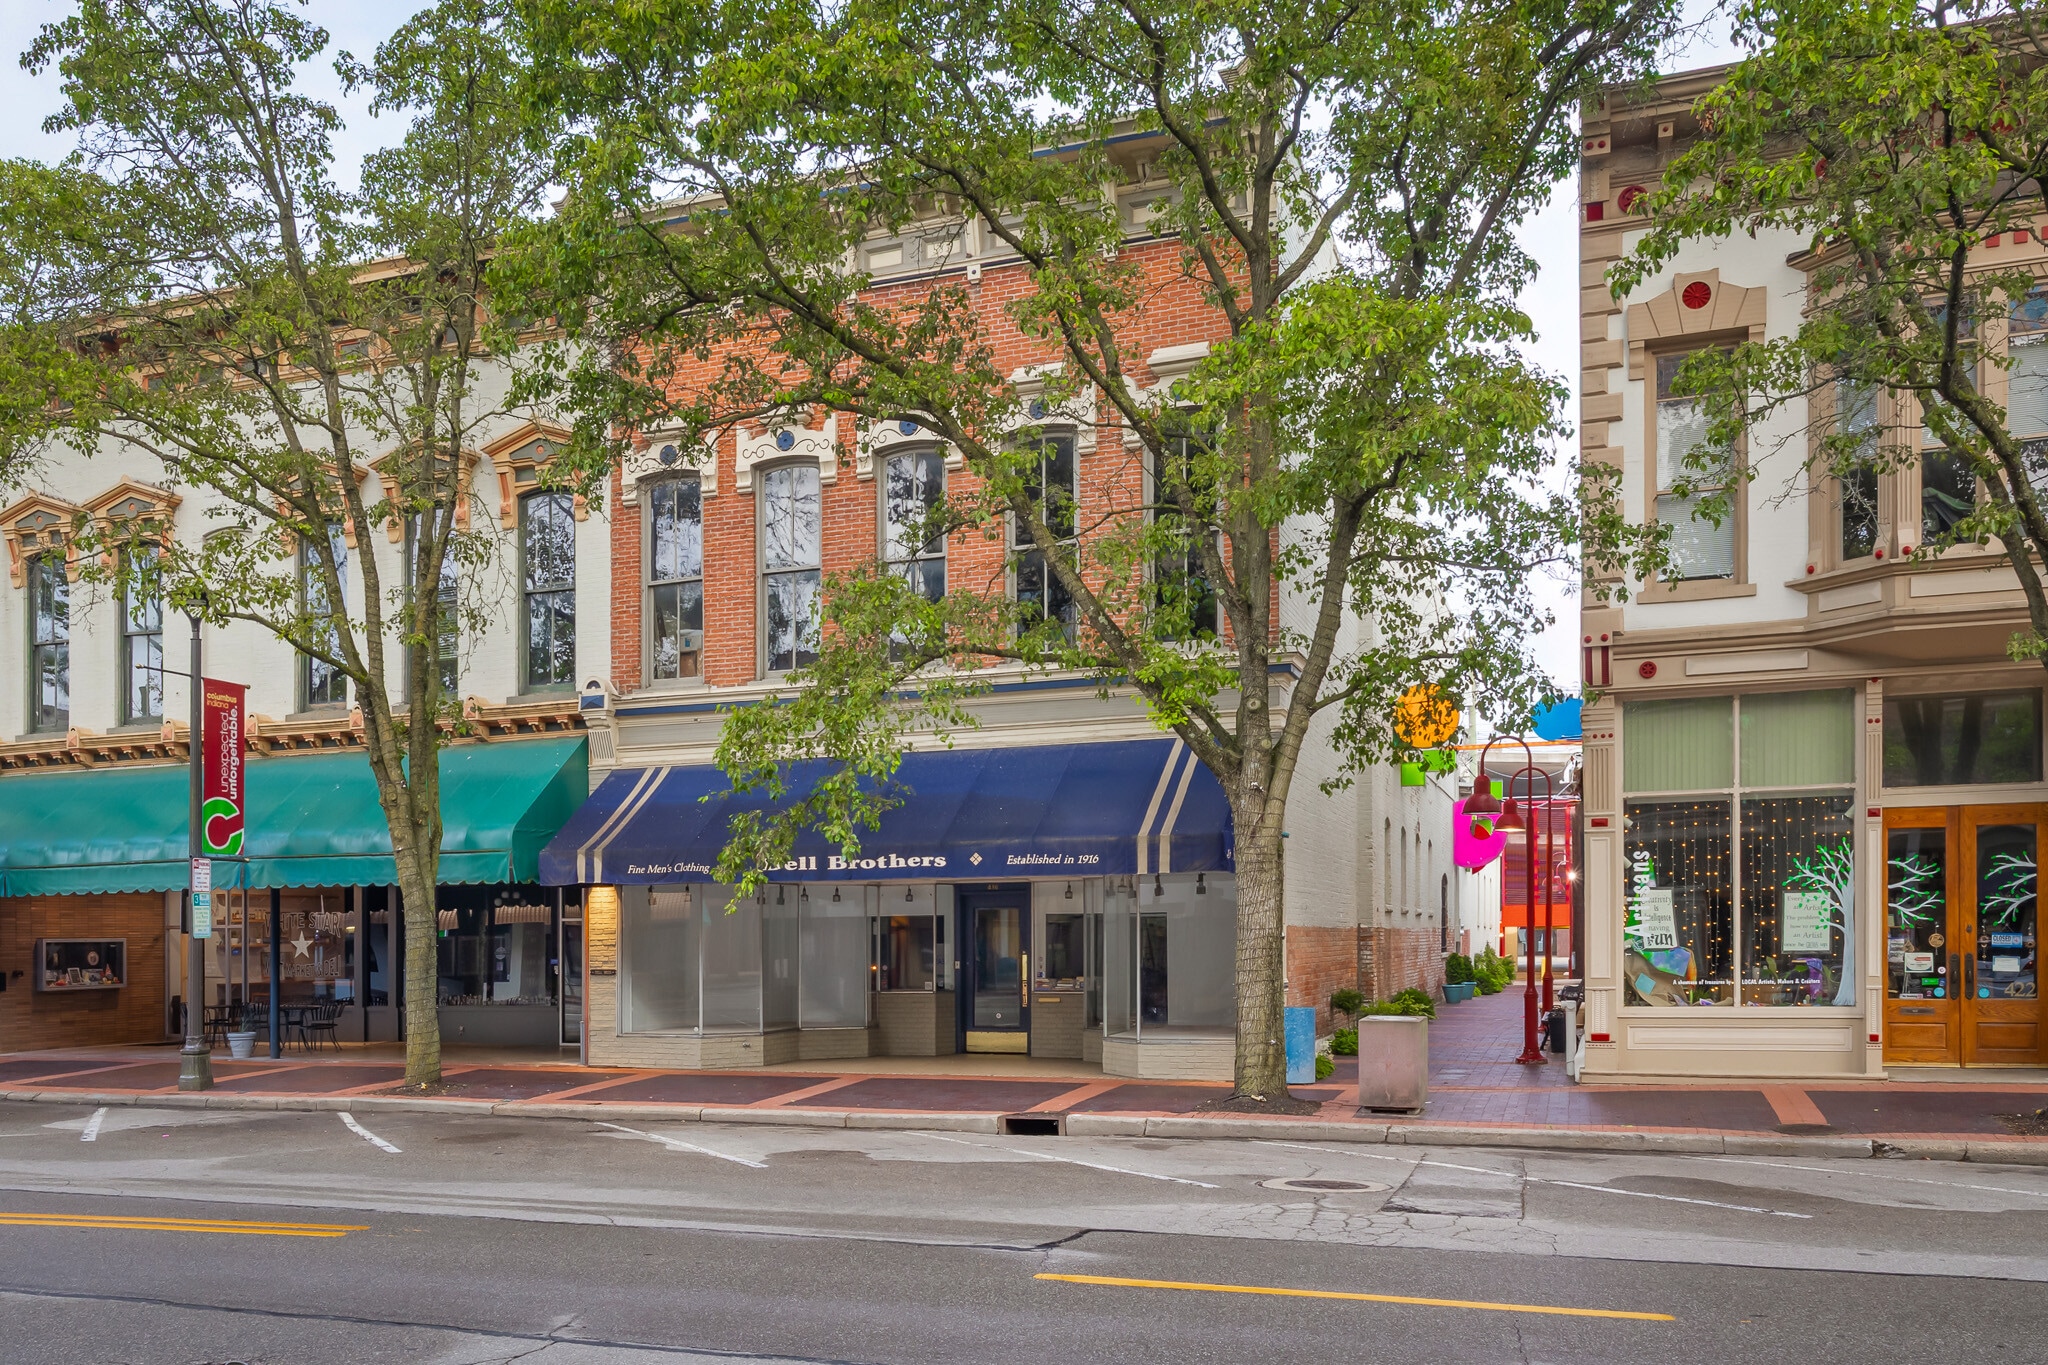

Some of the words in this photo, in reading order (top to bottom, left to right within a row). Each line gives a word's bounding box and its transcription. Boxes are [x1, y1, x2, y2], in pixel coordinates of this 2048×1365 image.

[207, 700, 229, 709] indiana
[220, 710, 231, 793] unexpected.
[229, 705, 239, 800] unforgettable.
[628, 864, 645, 874] Fine
[647, 863, 672, 874] Men's
[674, 862, 710, 875] Clothing
[827, 853, 947, 871] Brothers
[1007, 854, 1061, 865] Established
[1064, 855, 1074, 864] in
[1077, 854, 1099, 864] 1916
[194, 895, 199, 904] 3
[1624, 851, 1651, 937] Artisans
[308, 911, 341, 938] STAR
[287, 963, 315, 978] MARKET
[324, 955, 342, 977] DELI
[2004, 982, 2037, 997] 422
